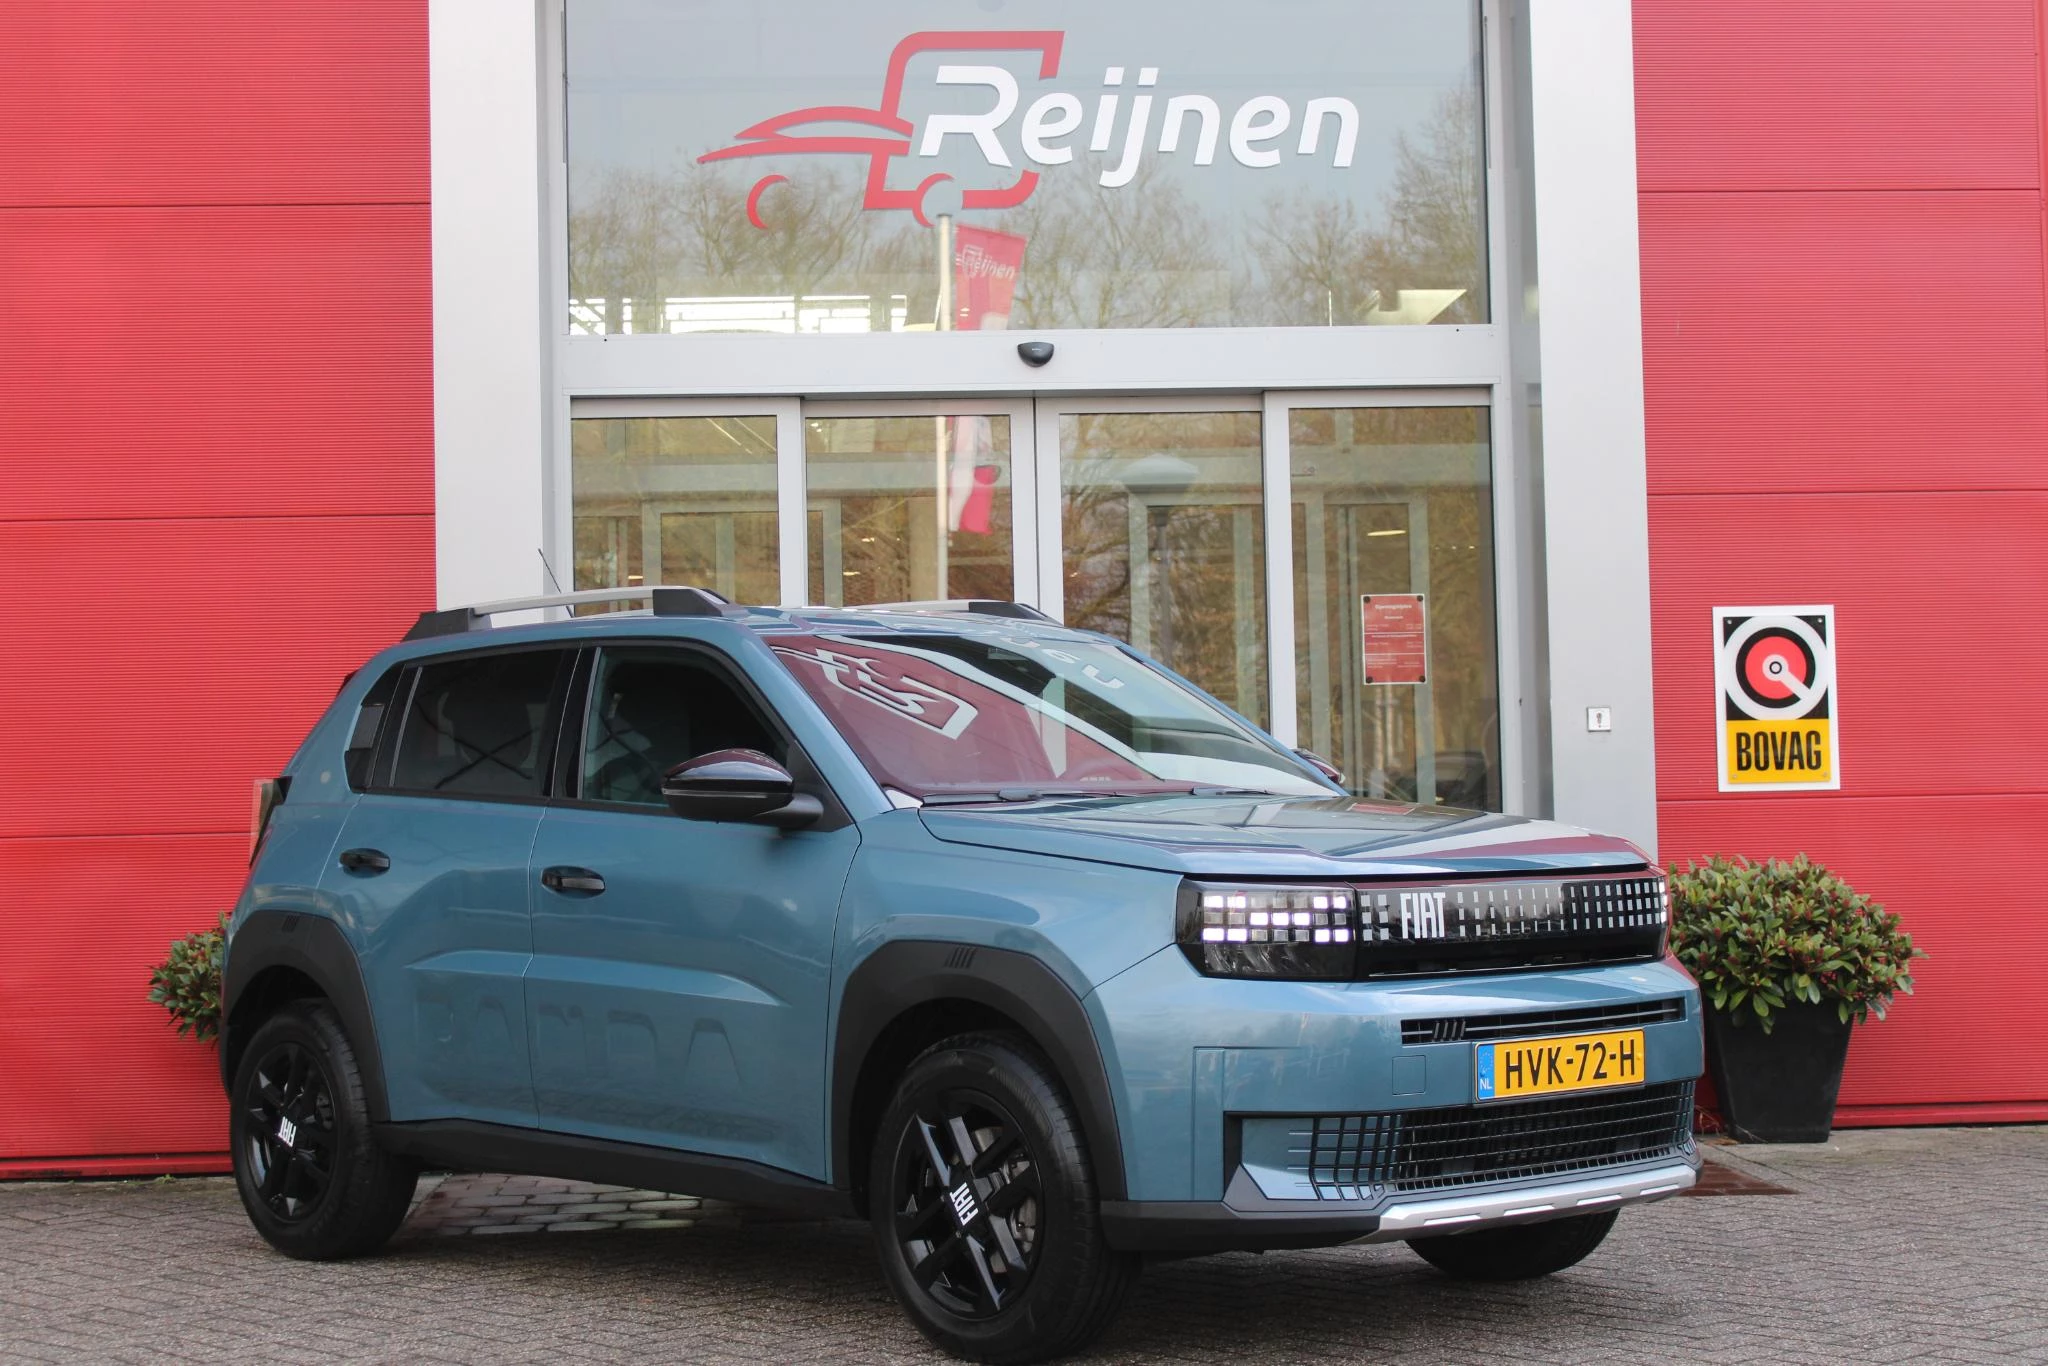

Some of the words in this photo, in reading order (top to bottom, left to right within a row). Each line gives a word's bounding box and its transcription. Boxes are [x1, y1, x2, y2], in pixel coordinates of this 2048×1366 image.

[919, 64, 1360, 188] Reijnen
[1735, 730, 1823, 772] BOVAG
[1399, 892, 1446, 939] FIAT
[1479, 1078, 1493, 1090] NL
[1505, 1038, 1636, 1090] HVK-72-H
[949, 1182, 979, 1226] FIAT
